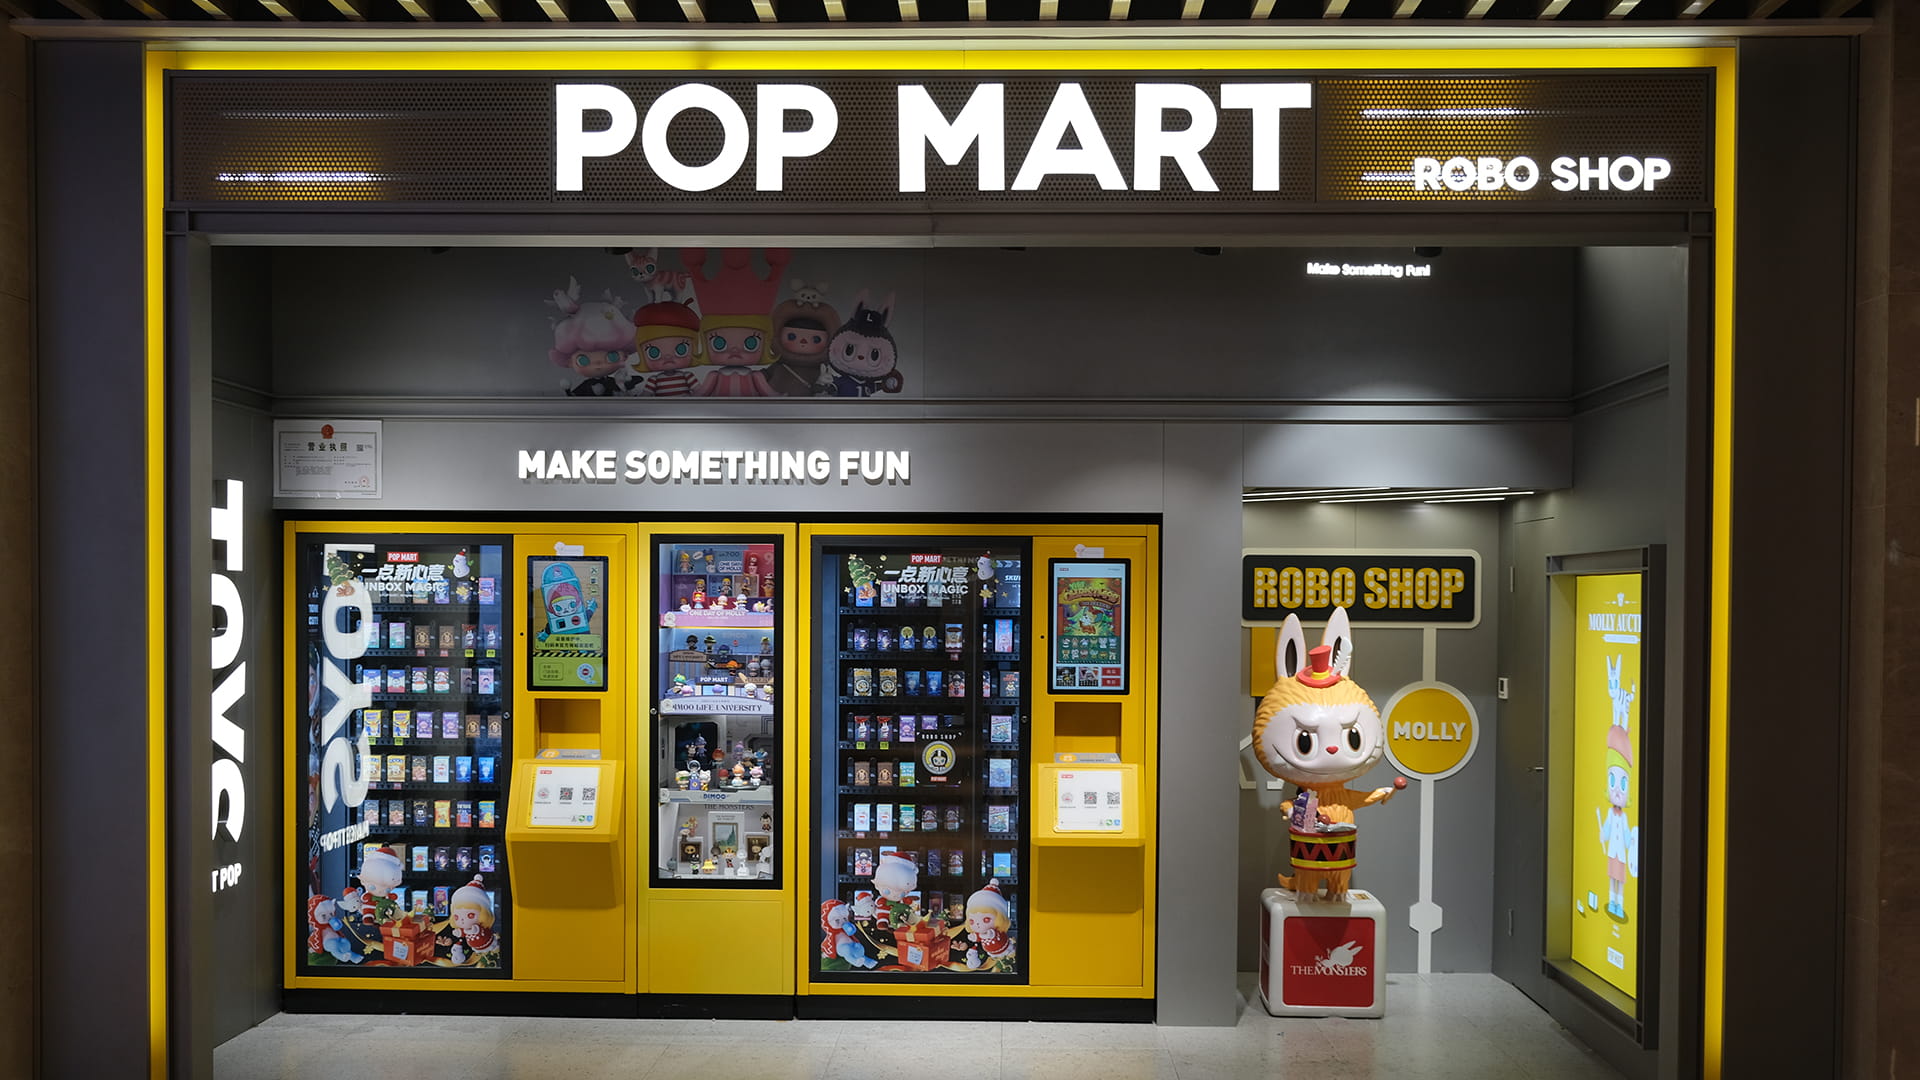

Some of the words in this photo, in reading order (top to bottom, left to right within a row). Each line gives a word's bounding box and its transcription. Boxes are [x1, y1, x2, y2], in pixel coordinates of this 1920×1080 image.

[555, 83, 839, 192] POP
[898, 83, 1312, 192] MART
[1414, 156, 1539, 192] ROBO
[1551, 156, 1671, 192] SHOP
[1307, 262, 1341, 275] Make
[1342, 264, 1404, 278] Something
[308, 442, 348, 452] 营业执照
[518, 450, 617, 479] MAKE
[624, 450, 830, 480] SOMETHING
[839, 450, 910, 480] FUN
[387, 553, 401, 561] POP
[402, 553, 418, 561] MART
[911, 555, 924, 563] POP
[924, 555, 942, 563] MART
[361, 564, 446, 582] 一点新心意
[884, 565, 969, 584] 一点新心意
[405, 582, 445, 593] MAGIC
[883, 583, 925, 594] UNBOX
[928, 584, 969, 595] MAGIC
[1253, 566, 1357, 610] ROBO
[1363, 567, 1466, 610] SHOP
[1588, 613, 1617, 631] MOLLY
[1393, 720, 1467, 741] MOLLY
[220, 862, 242, 890] POP
